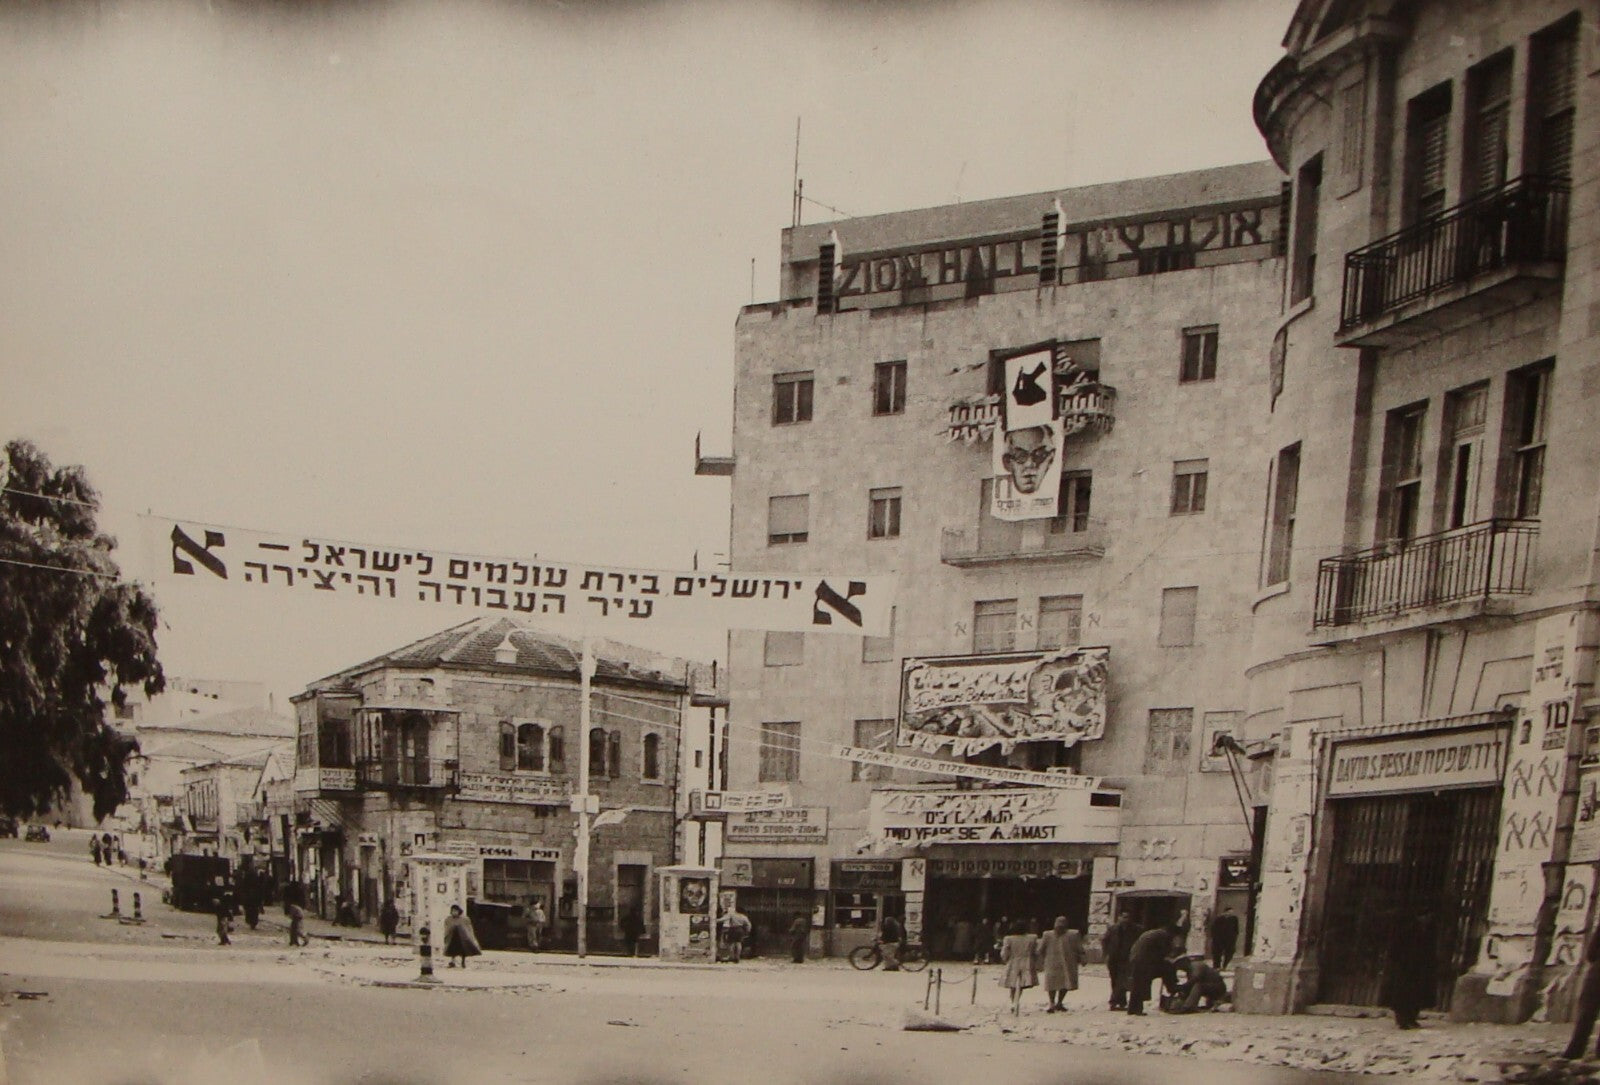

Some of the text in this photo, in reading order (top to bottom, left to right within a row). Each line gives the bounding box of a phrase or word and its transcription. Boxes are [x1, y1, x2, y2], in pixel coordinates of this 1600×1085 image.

[938, 241, 1038, 286] HALL
[171, 524, 228, 579] א
[303, 539, 802, 600] ירושלים בירת עולמים לישראל
[245, 562, 653, 619] עיר העבודה והיצירה
[813, 580, 866, 627] א
[733, 825, 760, 834] PHOTO
[763, 825, 794, 834] STUDIO
[884, 827, 911, 841] TWO
[1021, 825, 1057, 839] MAST
